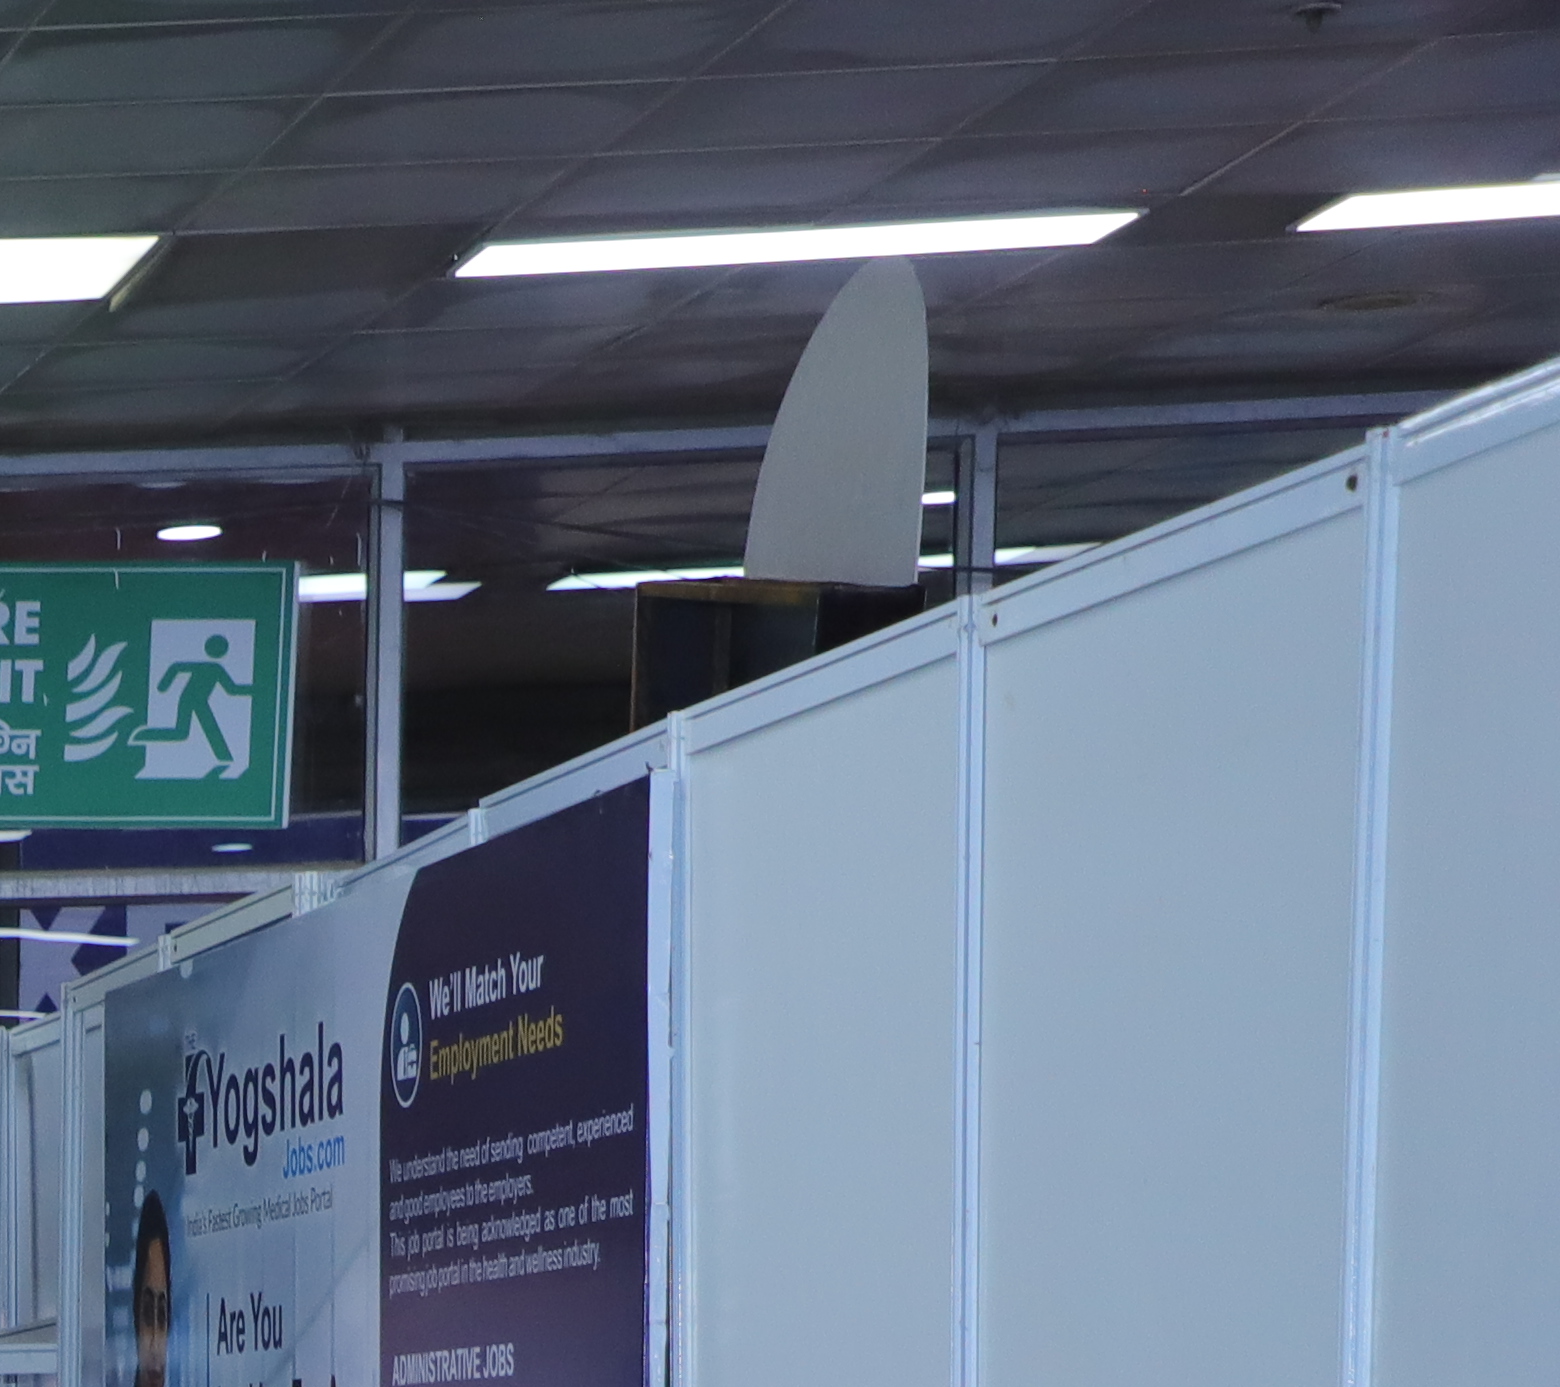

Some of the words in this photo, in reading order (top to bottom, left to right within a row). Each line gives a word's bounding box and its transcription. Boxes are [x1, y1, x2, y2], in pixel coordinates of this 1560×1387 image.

[465, 958, 506, 1009] Match
[510, 951, 544, 995] Your
[429, 1019, 514, 1086] Employment
[518, 1004, 563, 1056] Needs
[186, 1022, 343, 1166] Yogshala
[283, 1134, 345, 1179] Jobs.com
[403, 1148, 445, 1180] understand
[459, 1140, 480, 1168] need
[490, 1132, 523, 1163] sending
[577, 1103, 634, 1147] experienced
[208, 1206, 232, 1232] Fastest
[233, 1200, 262, 1230] Growing
[262, 1190, 290, 1223] Medical
[291, 1190, 309, 1217] Jobs
[310, 1186, 333, 1212] Portal
[408, 1225, 420, 1260] job
[422, 1223, 444, 1257] portal
[447, 1222, 454, 1248] is
[457, 1216, 479, 1250] being
[481, 1205, 541, 1242] acknowledged
[544, 1208, 555, 1232] as
[558, 1206, 575, 1229] one
[578, 1195, 589, 1226] of
[592, 1193, 606, 1222] the
[610, 1188, 633, 1218] most
[217, 1297, 246, 1356] Are
[251, 1292, 283, 1349] You
[392, 1346, 480, 1386] ADMINISTRATIVE
[483, 1343, 514, 1378] JOBS
